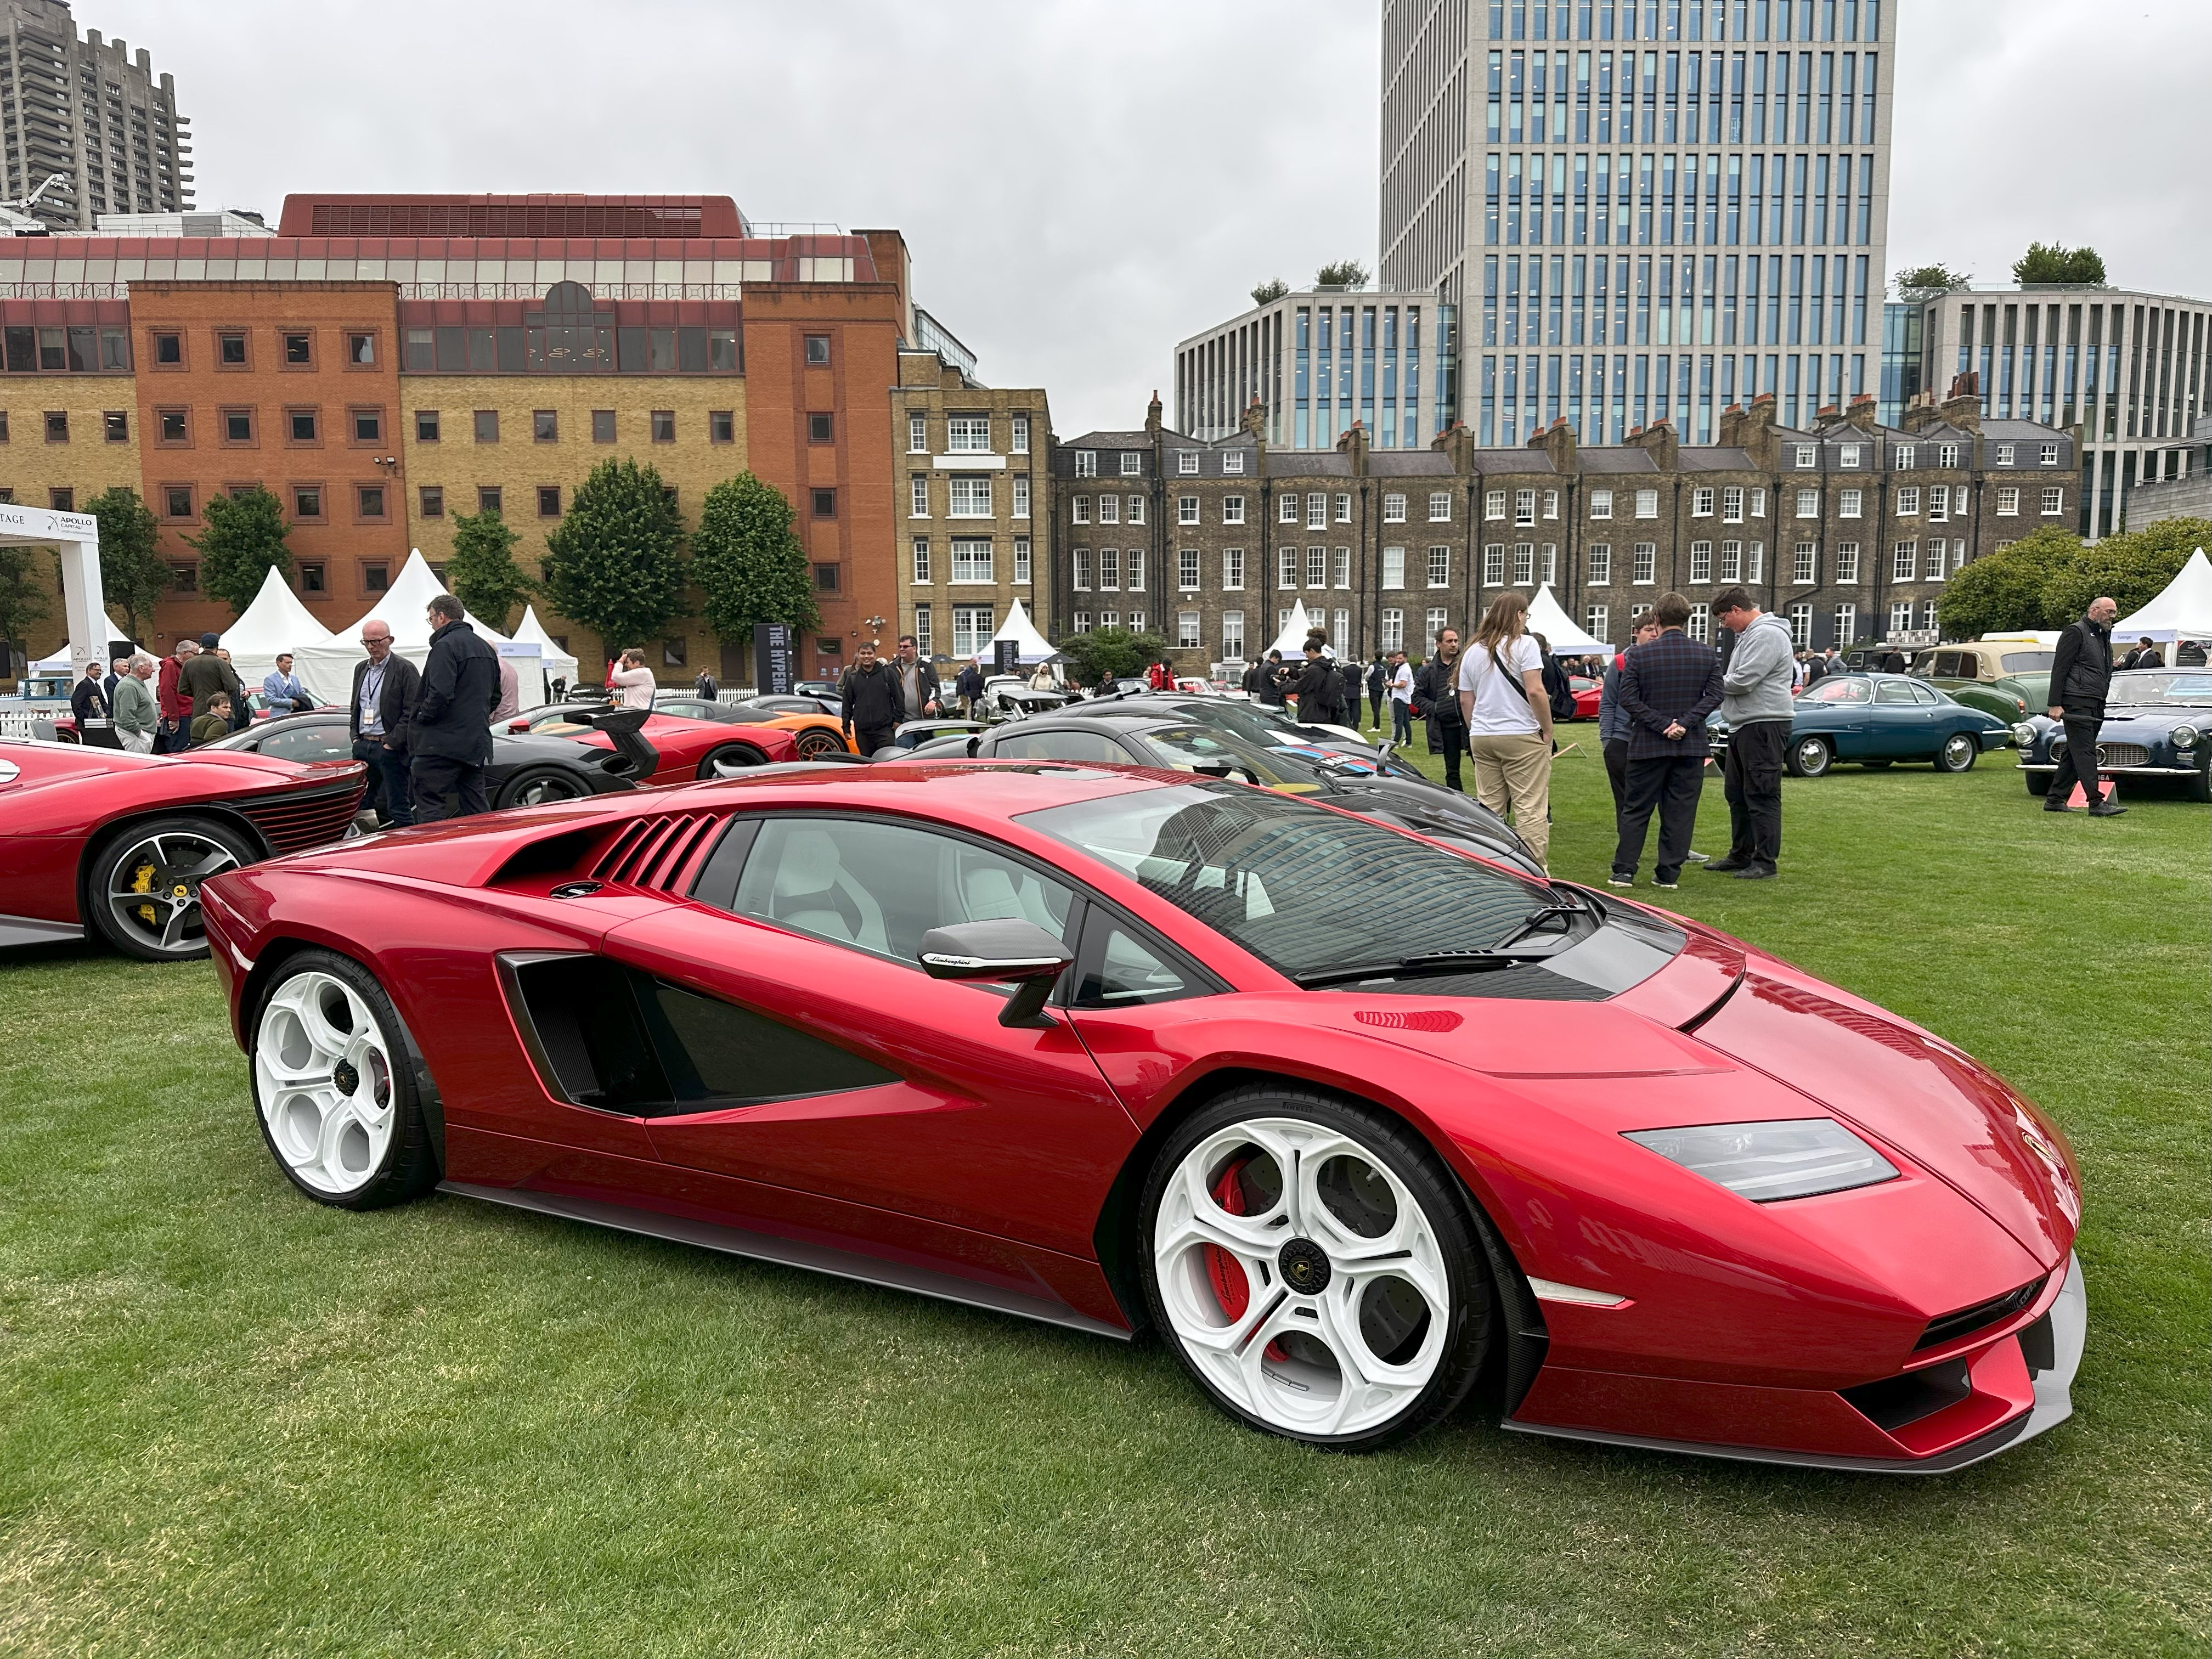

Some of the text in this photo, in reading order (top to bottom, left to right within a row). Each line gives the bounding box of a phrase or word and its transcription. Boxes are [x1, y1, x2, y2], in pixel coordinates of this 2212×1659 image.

[0, 514, 25, 524] TAGE
[61, 517, 92, 526] APOLLO
[769, 625, 787, 695] THE HYPERC
[1003, 642, 1012, 672] MERCE
[929, 956, 971, 965] Lamborghini
[1282, 1101, 1313, 1113] PIRELLI
[1214, 1245, 1233, 1305] Lamborghini
